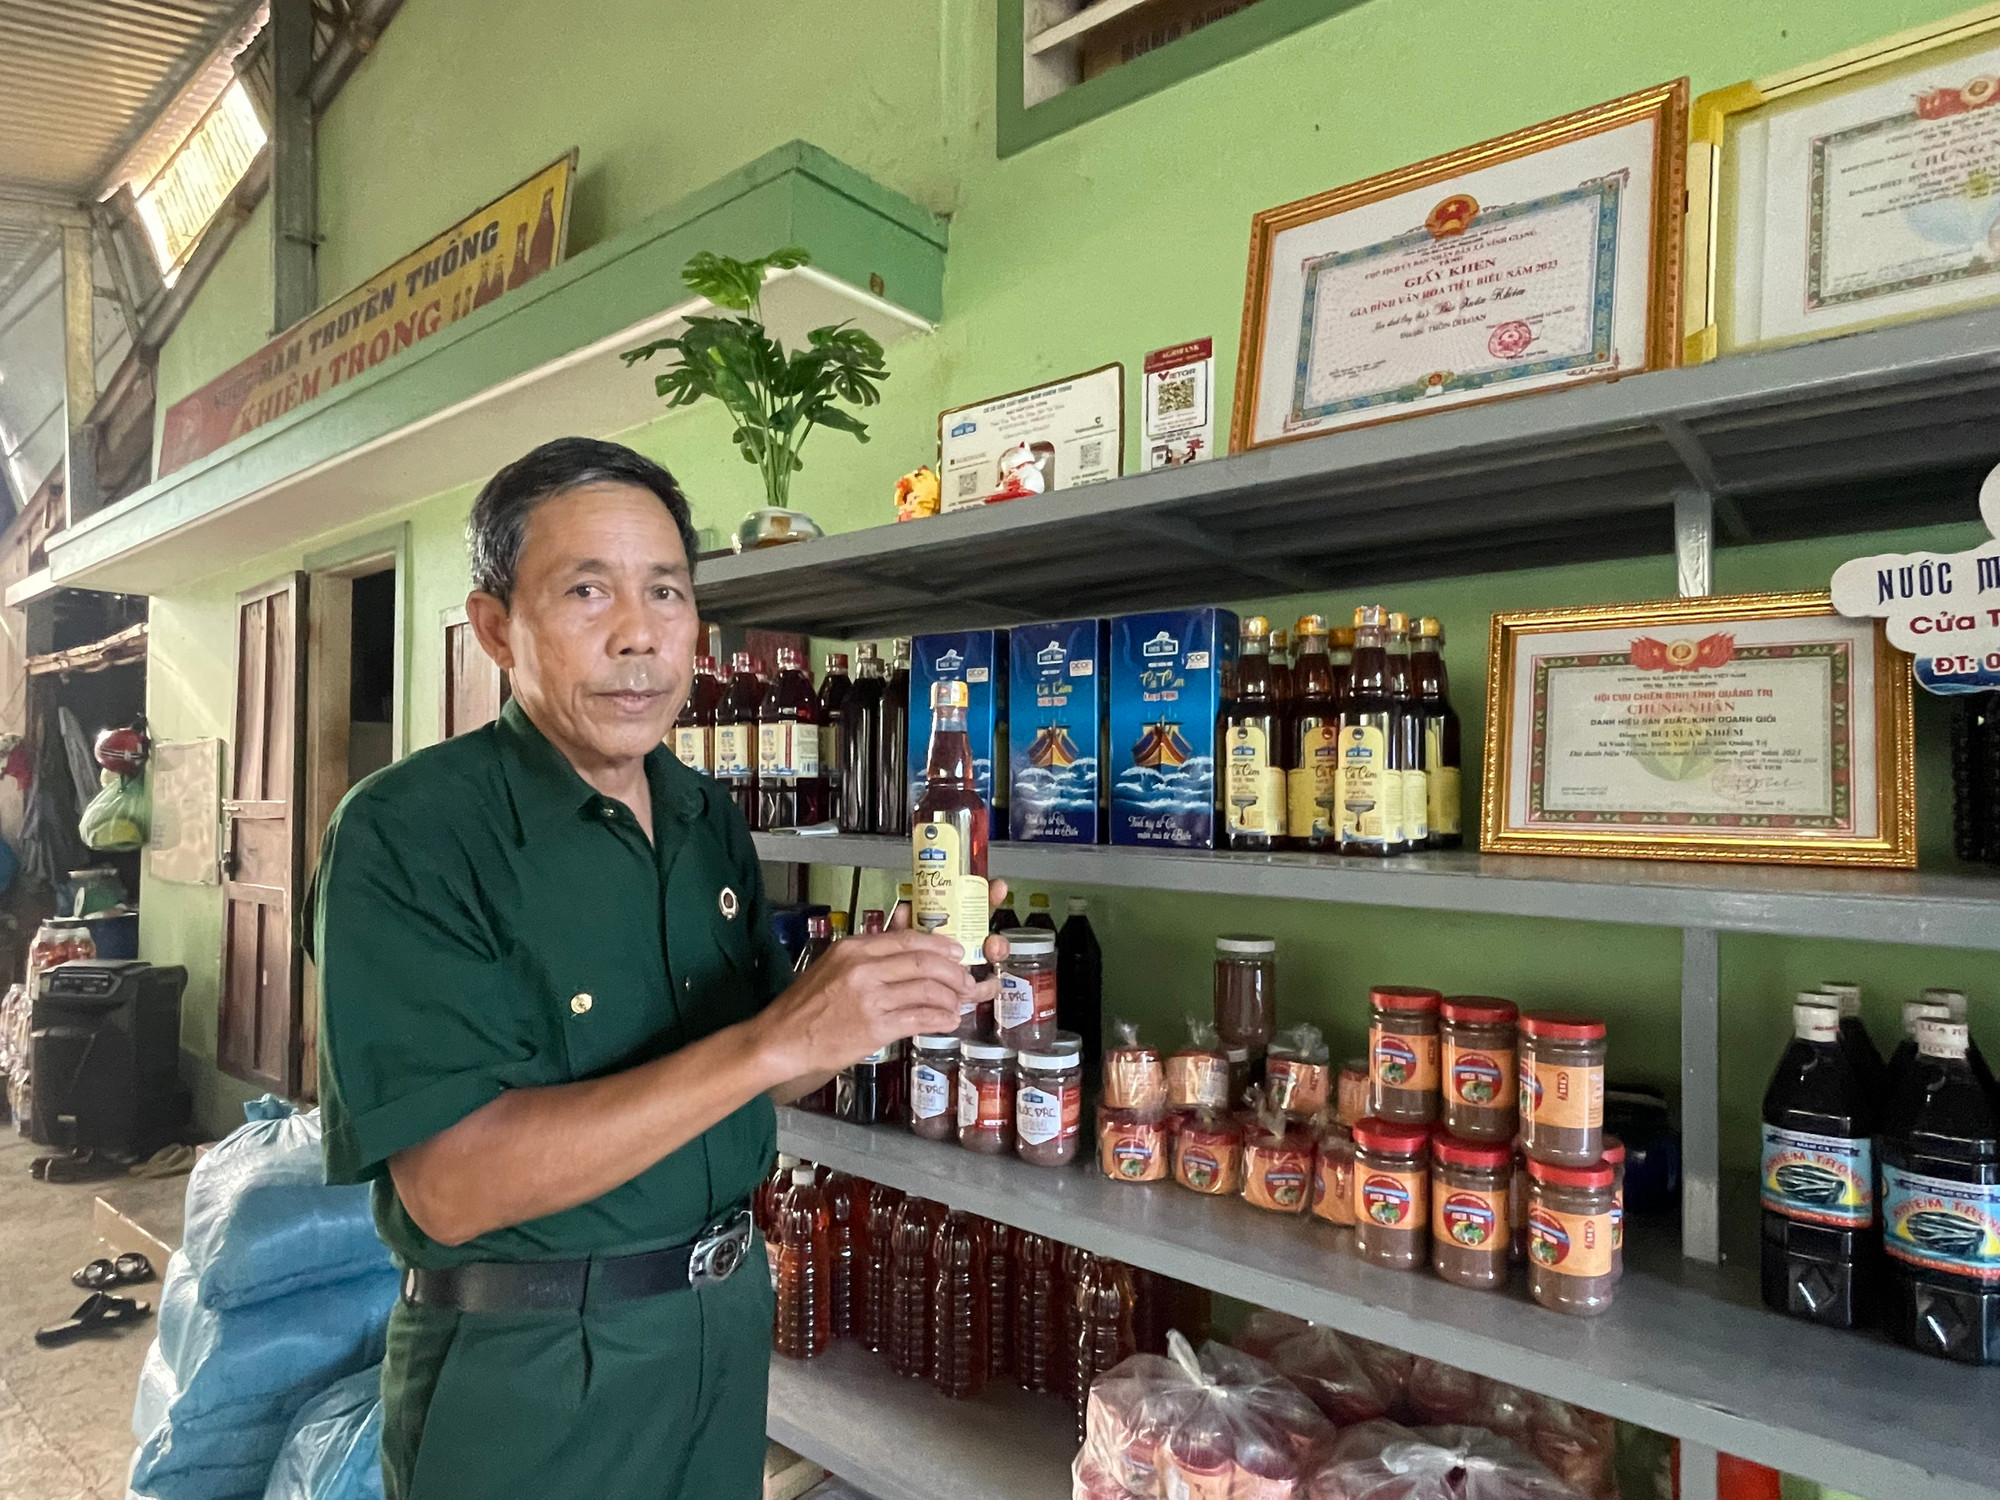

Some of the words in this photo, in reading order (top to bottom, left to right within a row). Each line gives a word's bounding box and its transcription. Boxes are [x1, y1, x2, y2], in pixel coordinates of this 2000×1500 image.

[1404, 268, 1442, 288] GIẤY
[1449, 258, 1497, 277] KHEN
[1350, 307, 1368, 318] GIA
[1506, 265, 1533, 278] NĂM
[1877, 559, 1952, 605] NƯỚC
[1909, 611, 1976, 635] Cửa
[1934, 655, 1976, 673] ĐT:
[1718, 715, 1753, 723] DOANH
